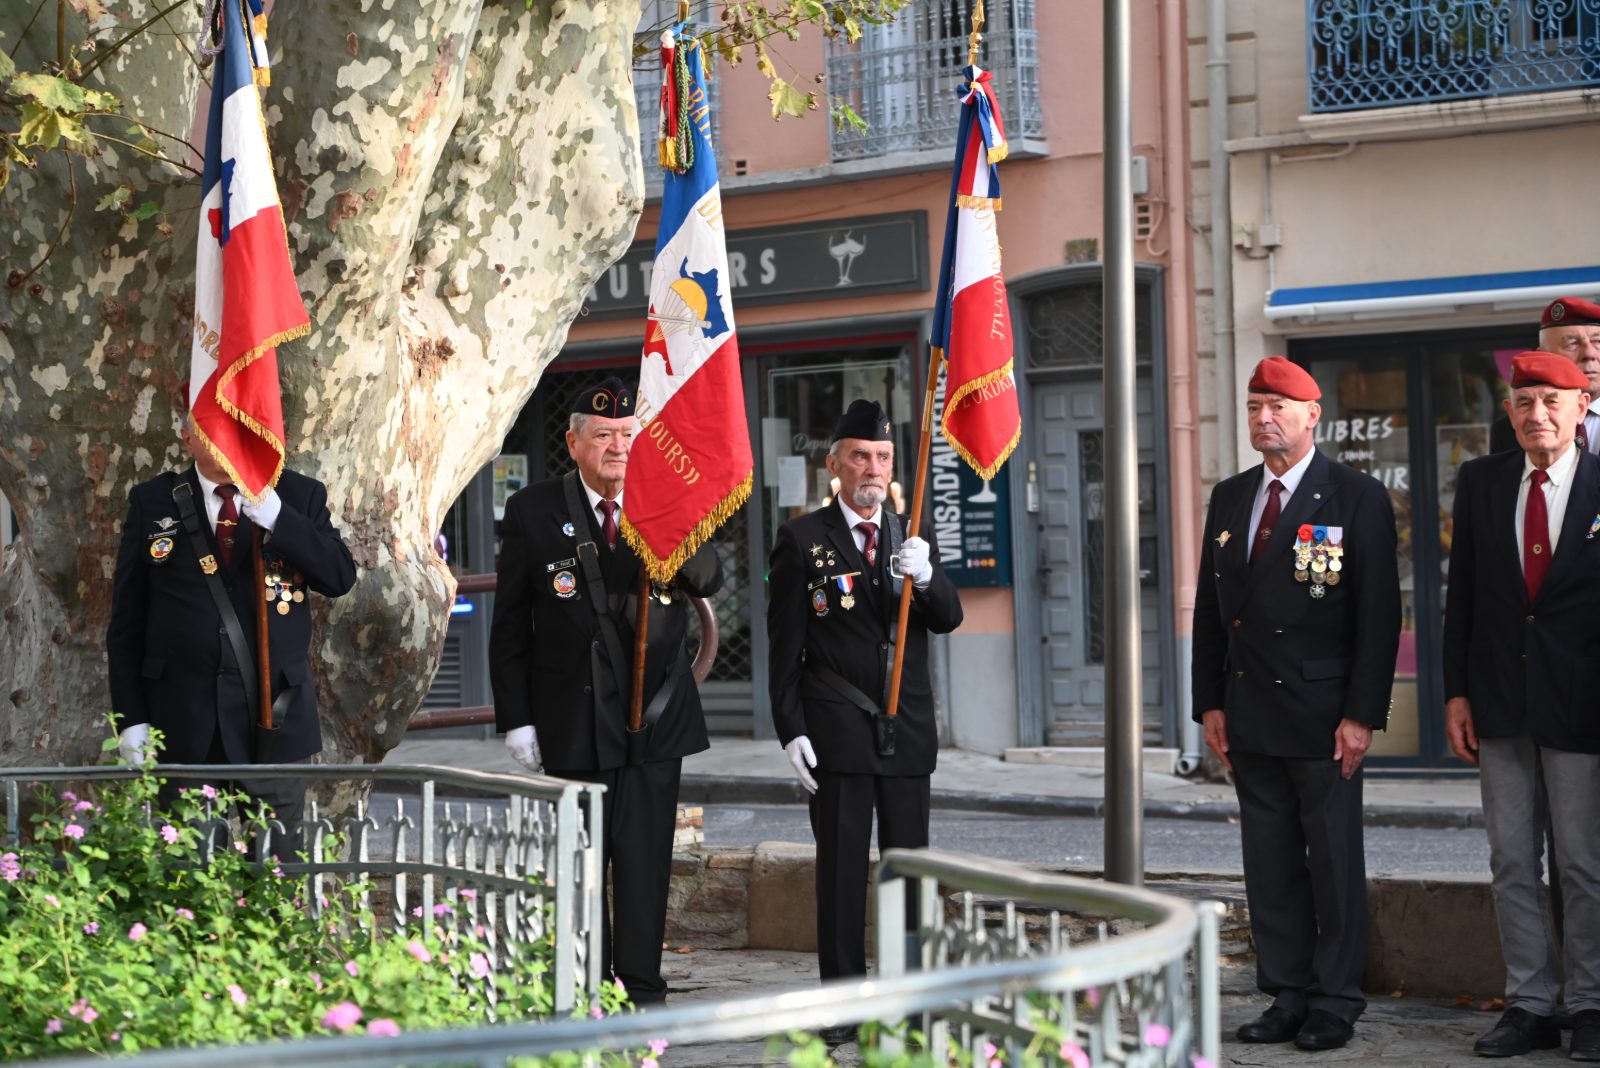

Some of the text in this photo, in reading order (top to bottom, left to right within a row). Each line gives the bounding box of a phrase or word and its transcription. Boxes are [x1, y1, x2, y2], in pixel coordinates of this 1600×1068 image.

[1314, 416, 1394, 444] LIBRES
[792, 432, 834, 458] Depui
[933, 505, 962, 564] VINS
